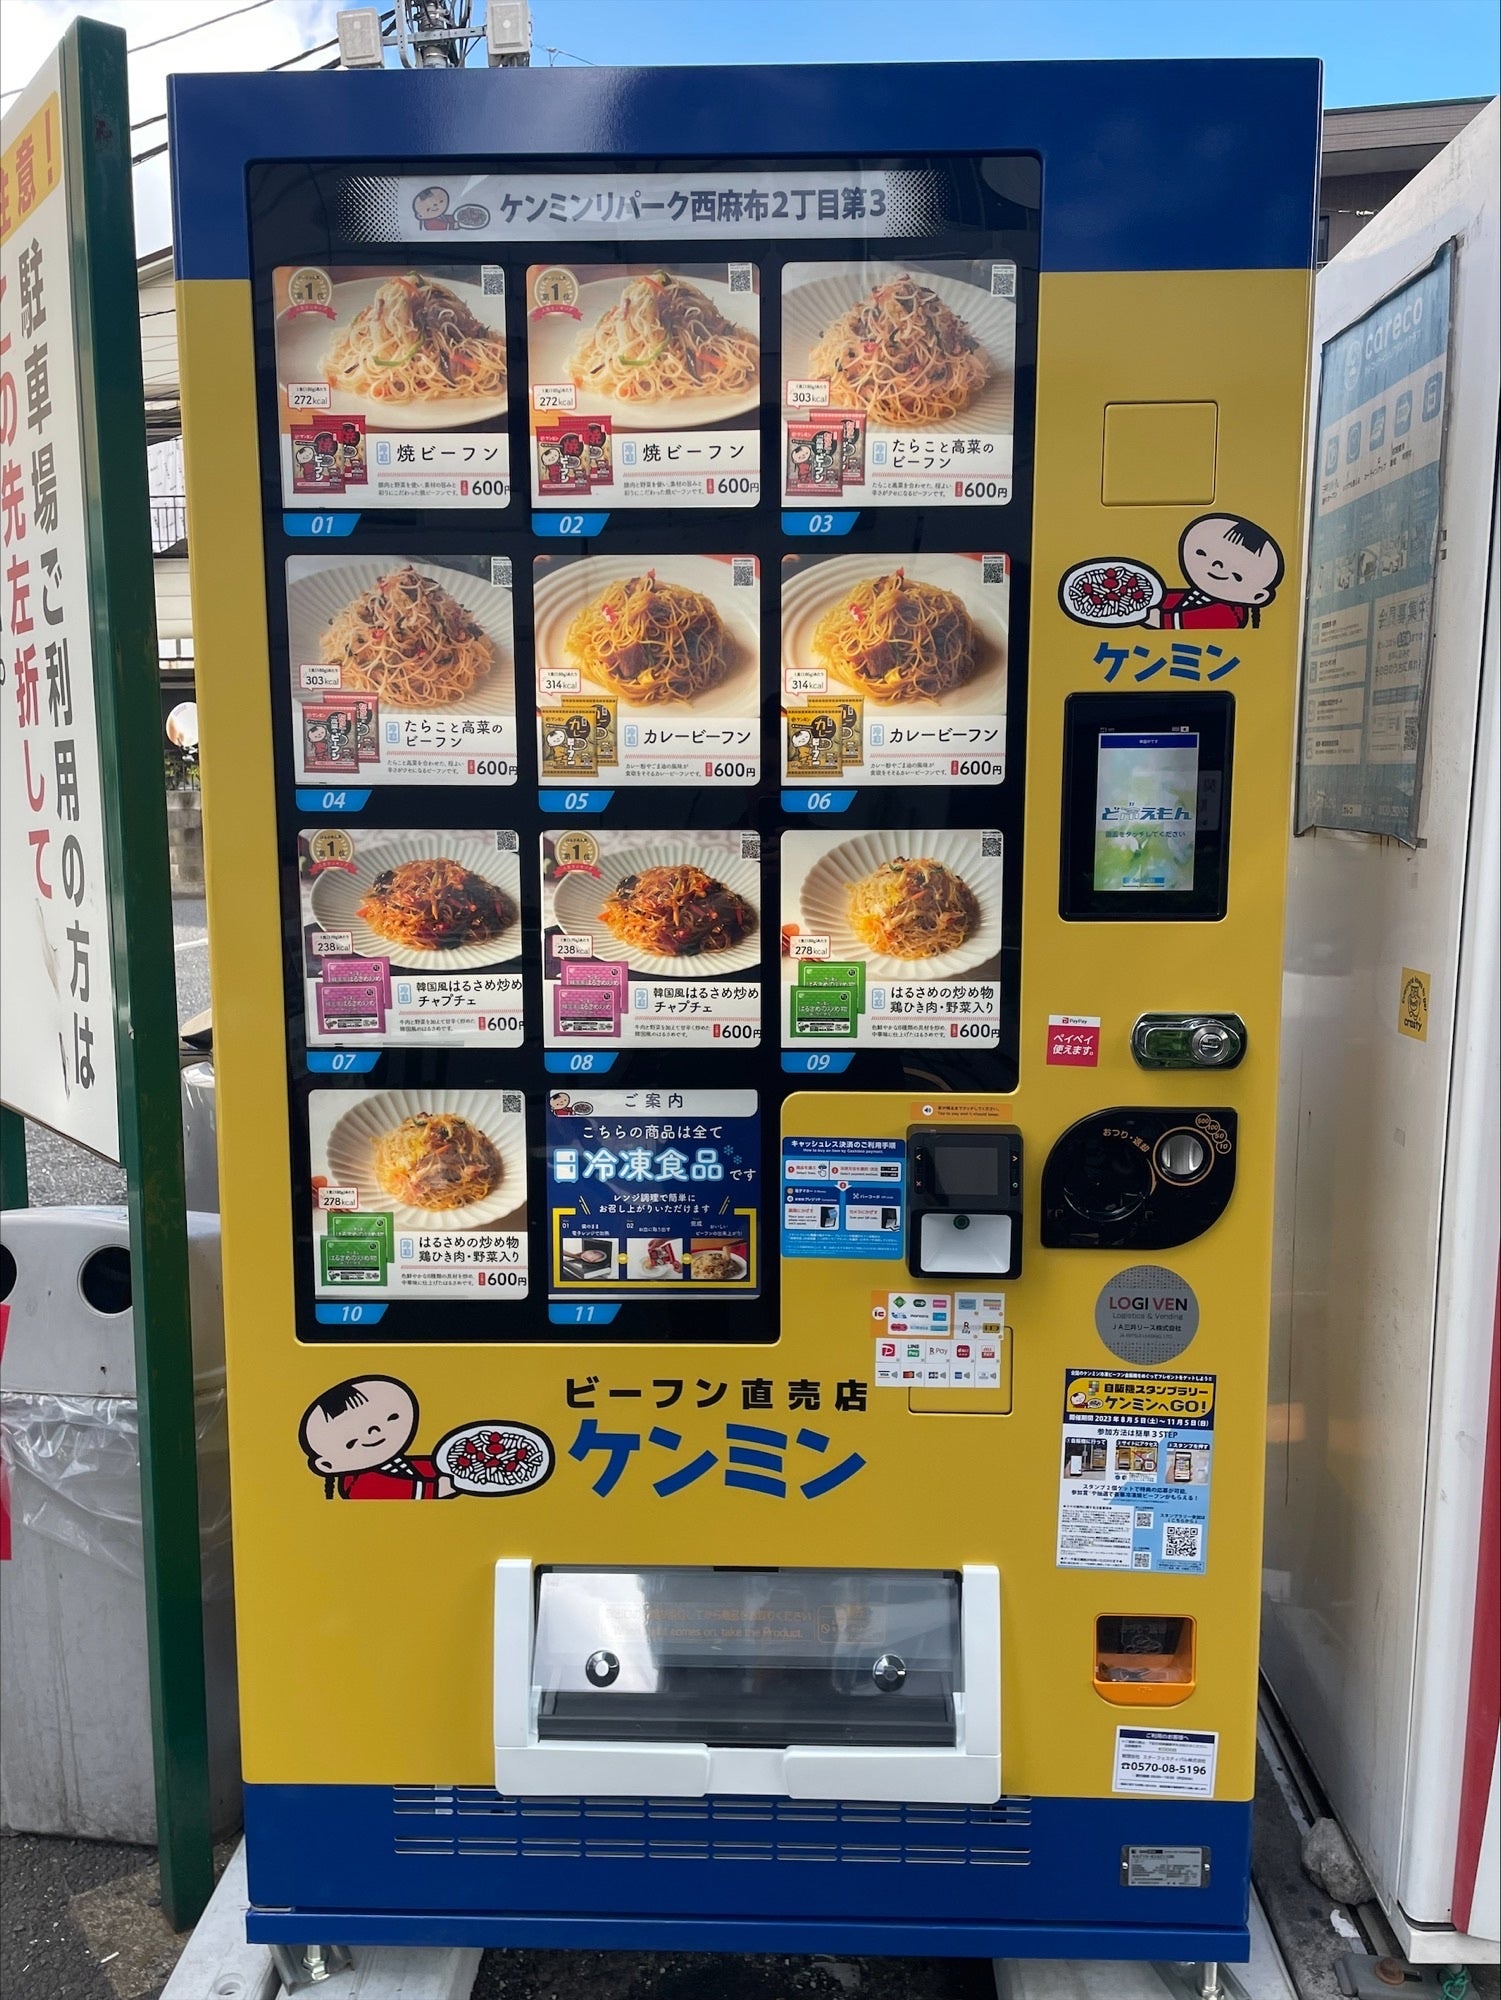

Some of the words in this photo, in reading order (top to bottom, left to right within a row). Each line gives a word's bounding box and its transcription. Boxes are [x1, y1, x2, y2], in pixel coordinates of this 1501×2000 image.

[500, 187, 886, 224] ケンミンリパーク西麻布2丁目第3
[1364, 296, 1423, 360] careco
[294, 395, 328, 405] 272kcal
[539, 396, 573, 407] 272kcal
[792, 393, 828, 403] 303kcal
[396, 444, 499, 463] 焼ビーフン
[642, 443, 745, 463] 焼ビーフン
[892, 439, 994, 454] たらこと高菜の
[314, 454, 323, 482] ビーフン
[560, 455, 569, 483] ビーフン
[893, 456, 952, 469] ビーフン
[964, 482, 1008, 499] 600円
[311, 516, 334, 534] 01
[559, 516, 582, 534] 02
[809, 515, 833, 533] 03
[18, 237, 95, 1089] 駐車場ご利用の方は
[1093, 642, 1241, 683] ケンミン
[305, 675, 340, 686] 303kcal
[545, 679, 577, 690] 314kcal
[791, 680, 824, 690] 314kcal
[404, 719, 503, 735] たらこと高菜の
[406, 736, 463, 748] ビーフン
[643, 728, 751, 745] カレービーフン
[889, 727, 999, 744] カレービーフン
[714, 762, 756, 778] 600円
[960, 760, 1002, 776] 600円
[322, 792, 346, 809] 04
[564, 793, 588, 810] 05
[807, 792, 831, 810] 06
[317, 942, 351, 953] 238kcal
[557, 945, 589, 955] 238kcal
[795, 946, 828, 955] 278kcal
[416, 979, 523, 992] 韓国風はるさめ炒め
[891, 986, 994, 999] はるさめの炒め物
[418, 994, 477, 1007] チャプチェ
[653, 987, 759, 1000] 韓国風はるさめ炒め
[654, 1001, 713, 1013] チャプチェ
[890, 1001, 994, 1014] 鶏ひき肉・野菜入り
[1053, 1033, 1094, 1045] ペイペイ
[1052, 1044, 1094, 1056] 使えます。
[332, 1054, 356, 1070] 07
[570, 1055, 593, 1070] 08
[806, 1054, 830, 1070] 09
[625, 1092, 684, 1109] ご案内
[582, 1125, 723, 1140] こちらの商品は全て
[791, 1140, 896, 1150] キャッシュレス決済のご利用手順
[582, 1146, 725, 1182] 冷凍食品
[729, 1169, 757, 1182] です
[323, 1197, 356, 1207] 278kcal
[613, 1193, 696, 1203] レンジ調理で簡単に
[599, 1204, 710, 1214] お召し上がりいただけます
[419, 1237, 519, 1249] はるさめの炒め物
[418, 1251, 519, 1263] 鶏ひき肉・野菜入り
[487, 1272, 527, 1286] 600円
[1109, 1296, 1149, 1311] LOGI
[1152, 1297, 1188, 1311] VEN
[341, 1306, 363, 1321] 10
[575, 1306, 594, 1322] 11
[1112, 1312, 1145, 1320] Logistics
[1147, 1312, 1153, 1320] &
[1154, 1312, 1184, 1321] Vending
[936, 1347, 948, 1356] Pay
[566, 1375, 868, 1412] ビーフン直売店
[1104, 1383, 1209, 1396] 自販機スタンプラリー
[1104, 1396, 1206, 1413] ケンミンへGO!
[1158, 1430, 1178, 1439] STEP
[567, 1418, 867, 1499] ケンミン
[1131, 1761, 1207, 1775] 0570-08-5196
